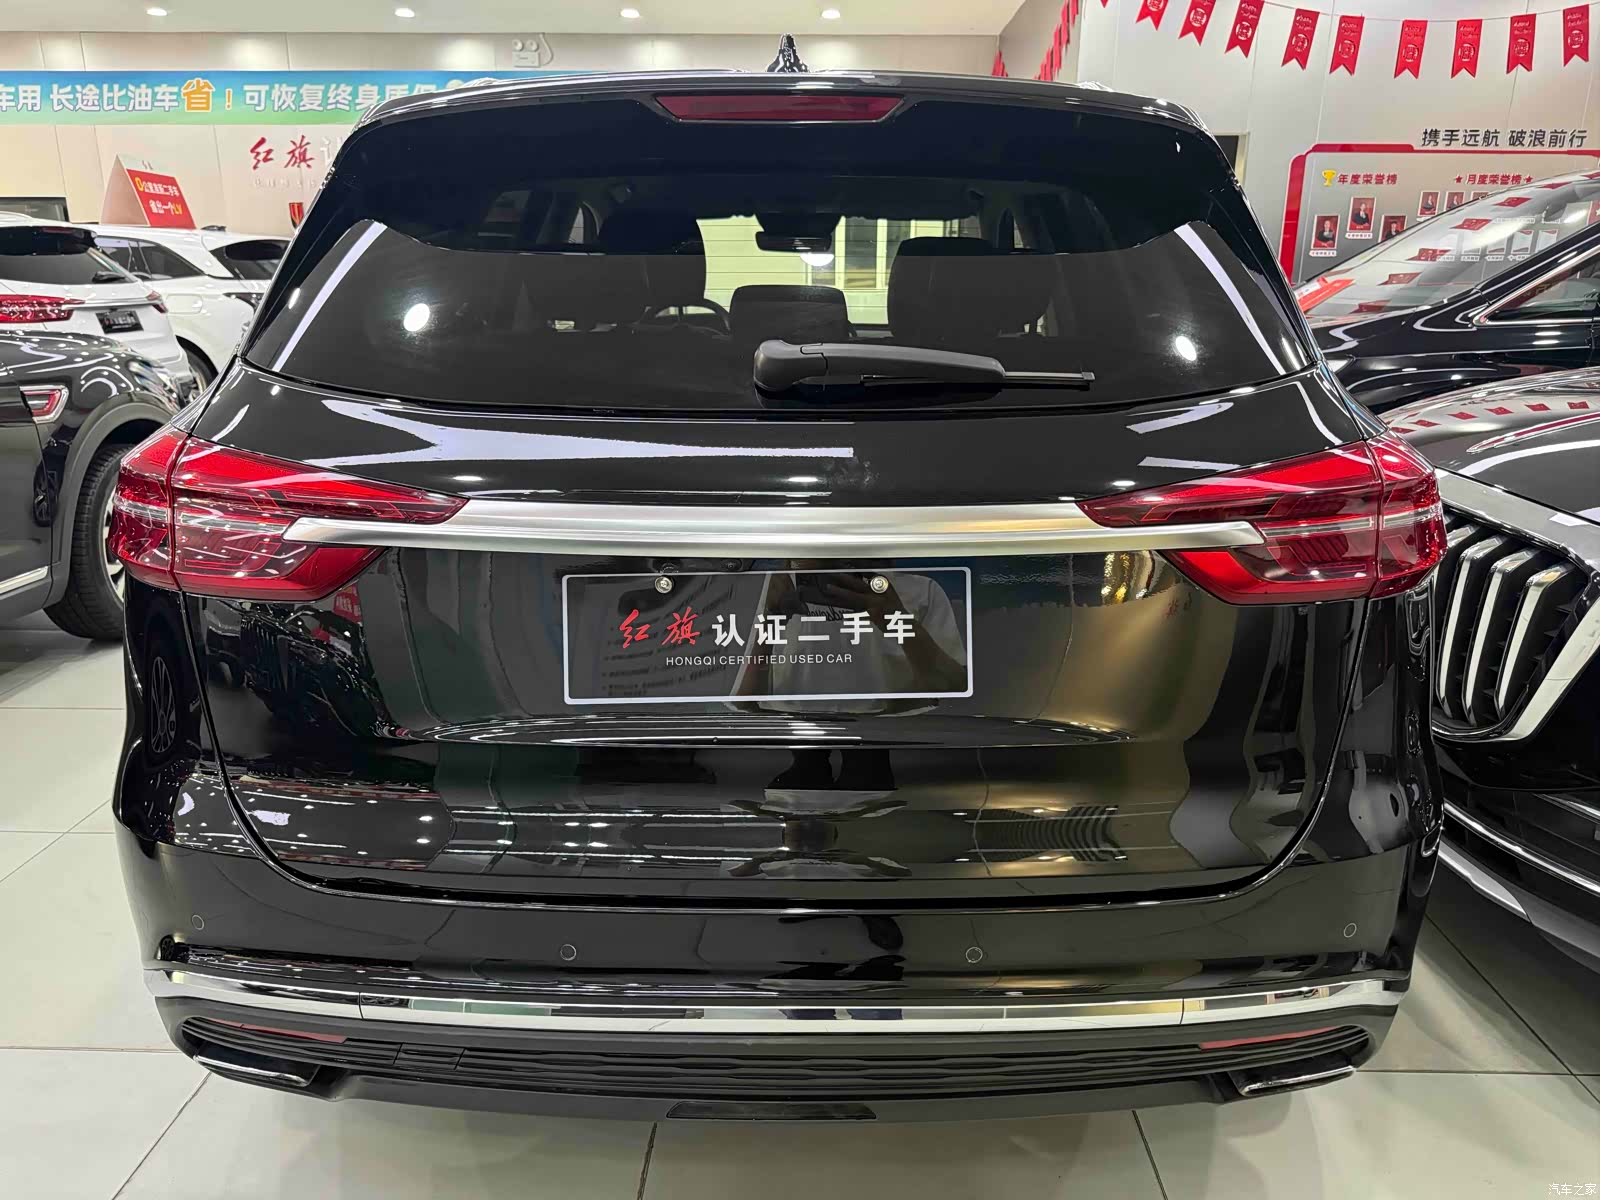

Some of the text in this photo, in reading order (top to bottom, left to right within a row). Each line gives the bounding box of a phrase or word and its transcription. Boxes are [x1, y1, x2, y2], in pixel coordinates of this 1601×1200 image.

[1422, 128, 1588, 148] 携手远航 破浪前行
[1338, 173, 1398, 185] 年度荣誉榜
[1466, 173, 1523, 185] 月度荣誉榜
[618, 606, 916, 649] 红旗认证二手车
[666, 653, 853, 666] HONGQI CERTIFIED USED CAR
